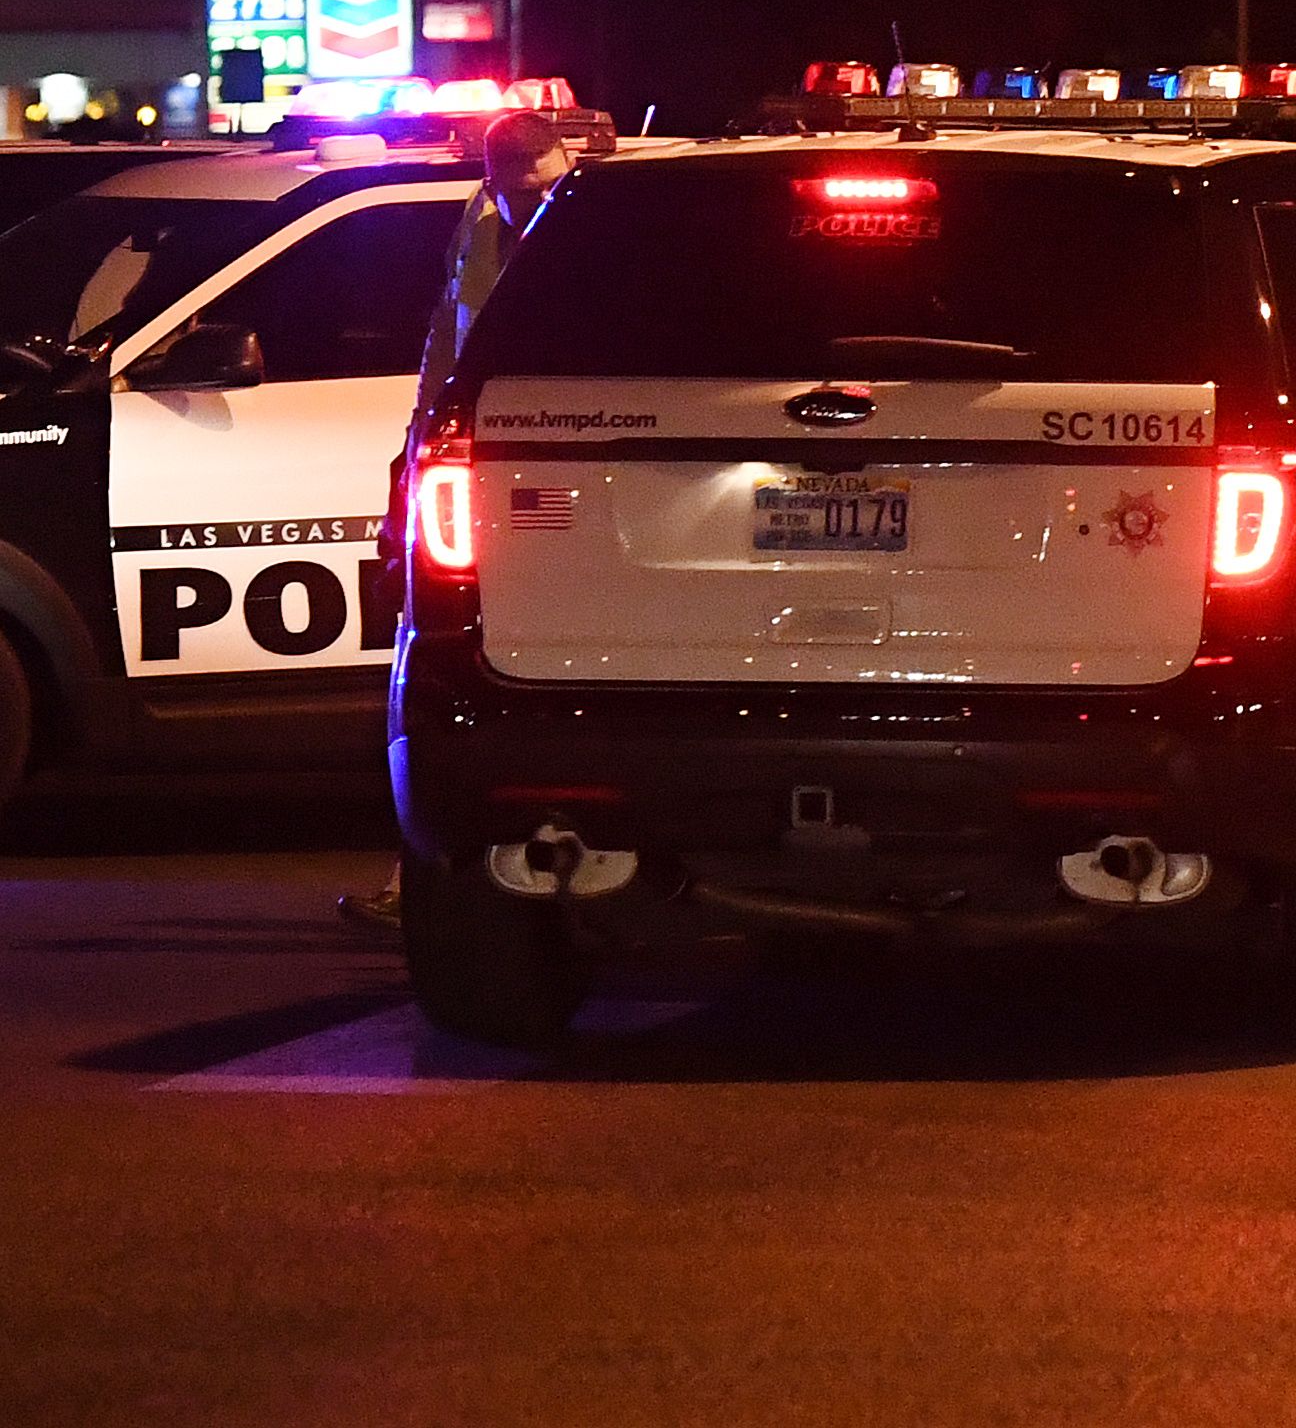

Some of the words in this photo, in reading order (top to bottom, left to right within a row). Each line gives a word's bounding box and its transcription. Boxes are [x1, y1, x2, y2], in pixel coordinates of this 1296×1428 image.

[788, 213, 942, 239] POLICE
[483, 410, 657, 432] www.lvmpd.com
[796, 477, 871, 493] NEVADA
[824, 497, 907, 538] 0179
[160, 526, 217, 548] LAS
[237, 521, 345, 543] VEGAS
